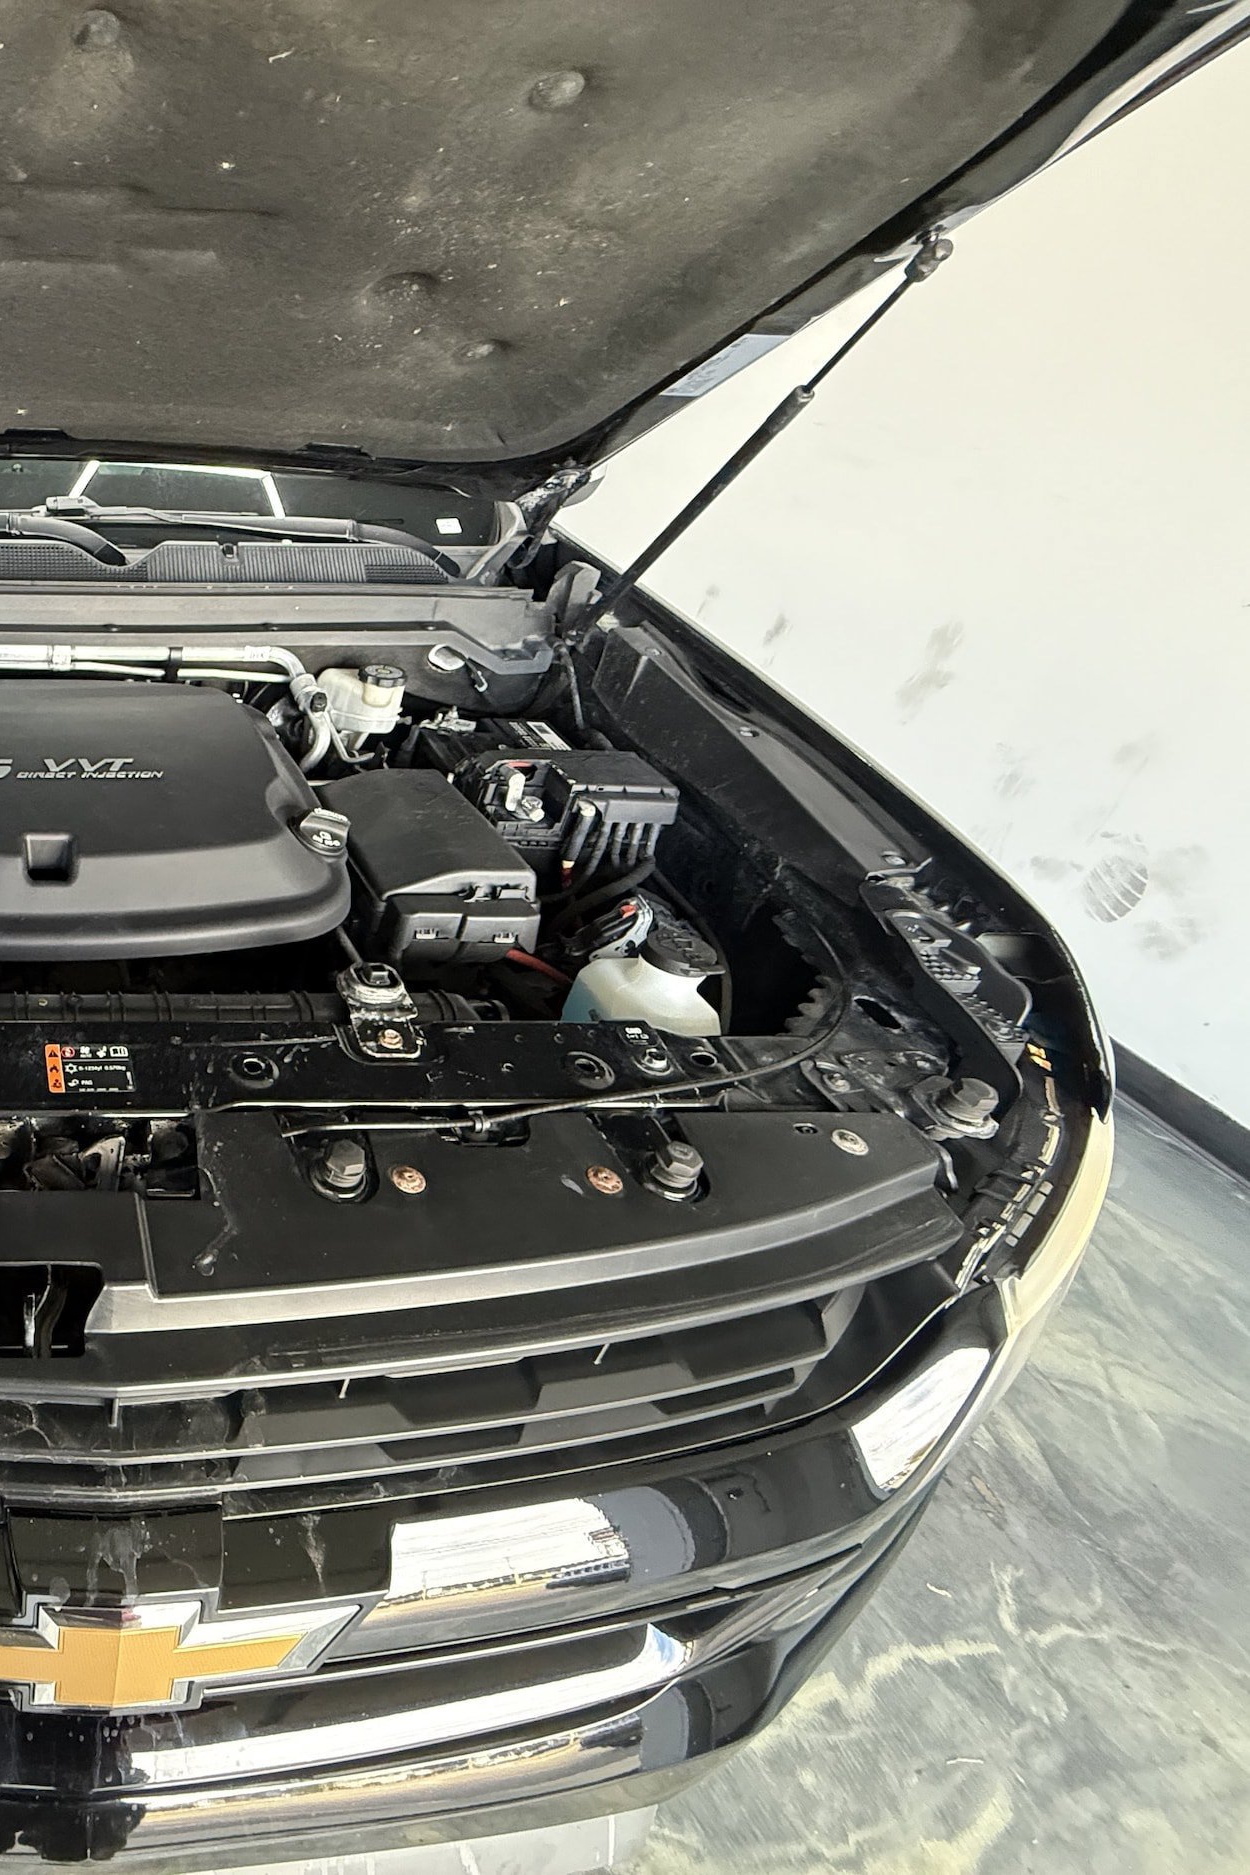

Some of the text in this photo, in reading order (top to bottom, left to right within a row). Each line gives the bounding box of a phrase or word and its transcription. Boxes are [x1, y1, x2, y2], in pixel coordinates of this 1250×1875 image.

[44, 758, 134, 772] VVT
[16, 771, 164, 779] DIRECT INJECTION
